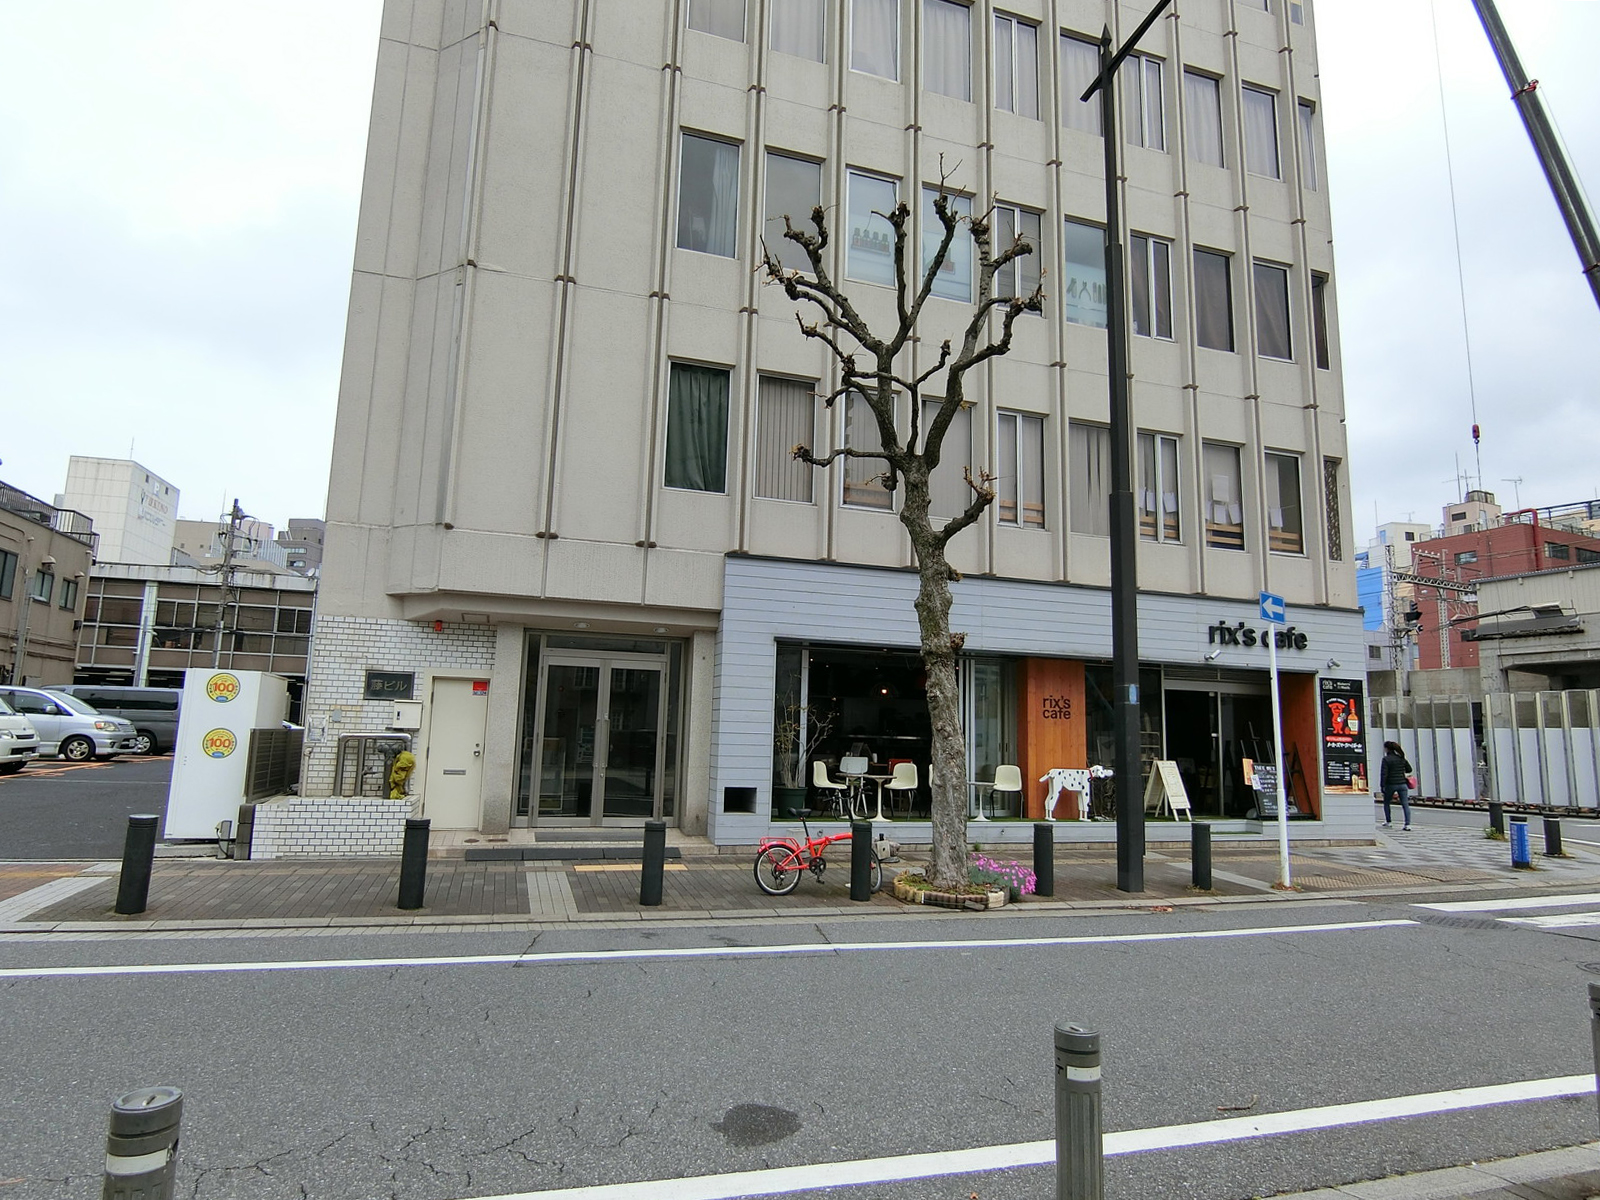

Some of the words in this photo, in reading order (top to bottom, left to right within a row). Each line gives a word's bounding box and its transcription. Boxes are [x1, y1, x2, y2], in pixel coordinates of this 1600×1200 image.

[1209, 620, 1257, 646] rix's
[1261, 626, 1308, 650] cafe
[212, 682, 235, 693] 100
[371, 679, 407, 691] 藤ビル
[1043, 695, 1071, 709] rix's
[1043, 707, 1071, 720] cafe
[208, 738, 231, 748] 100
